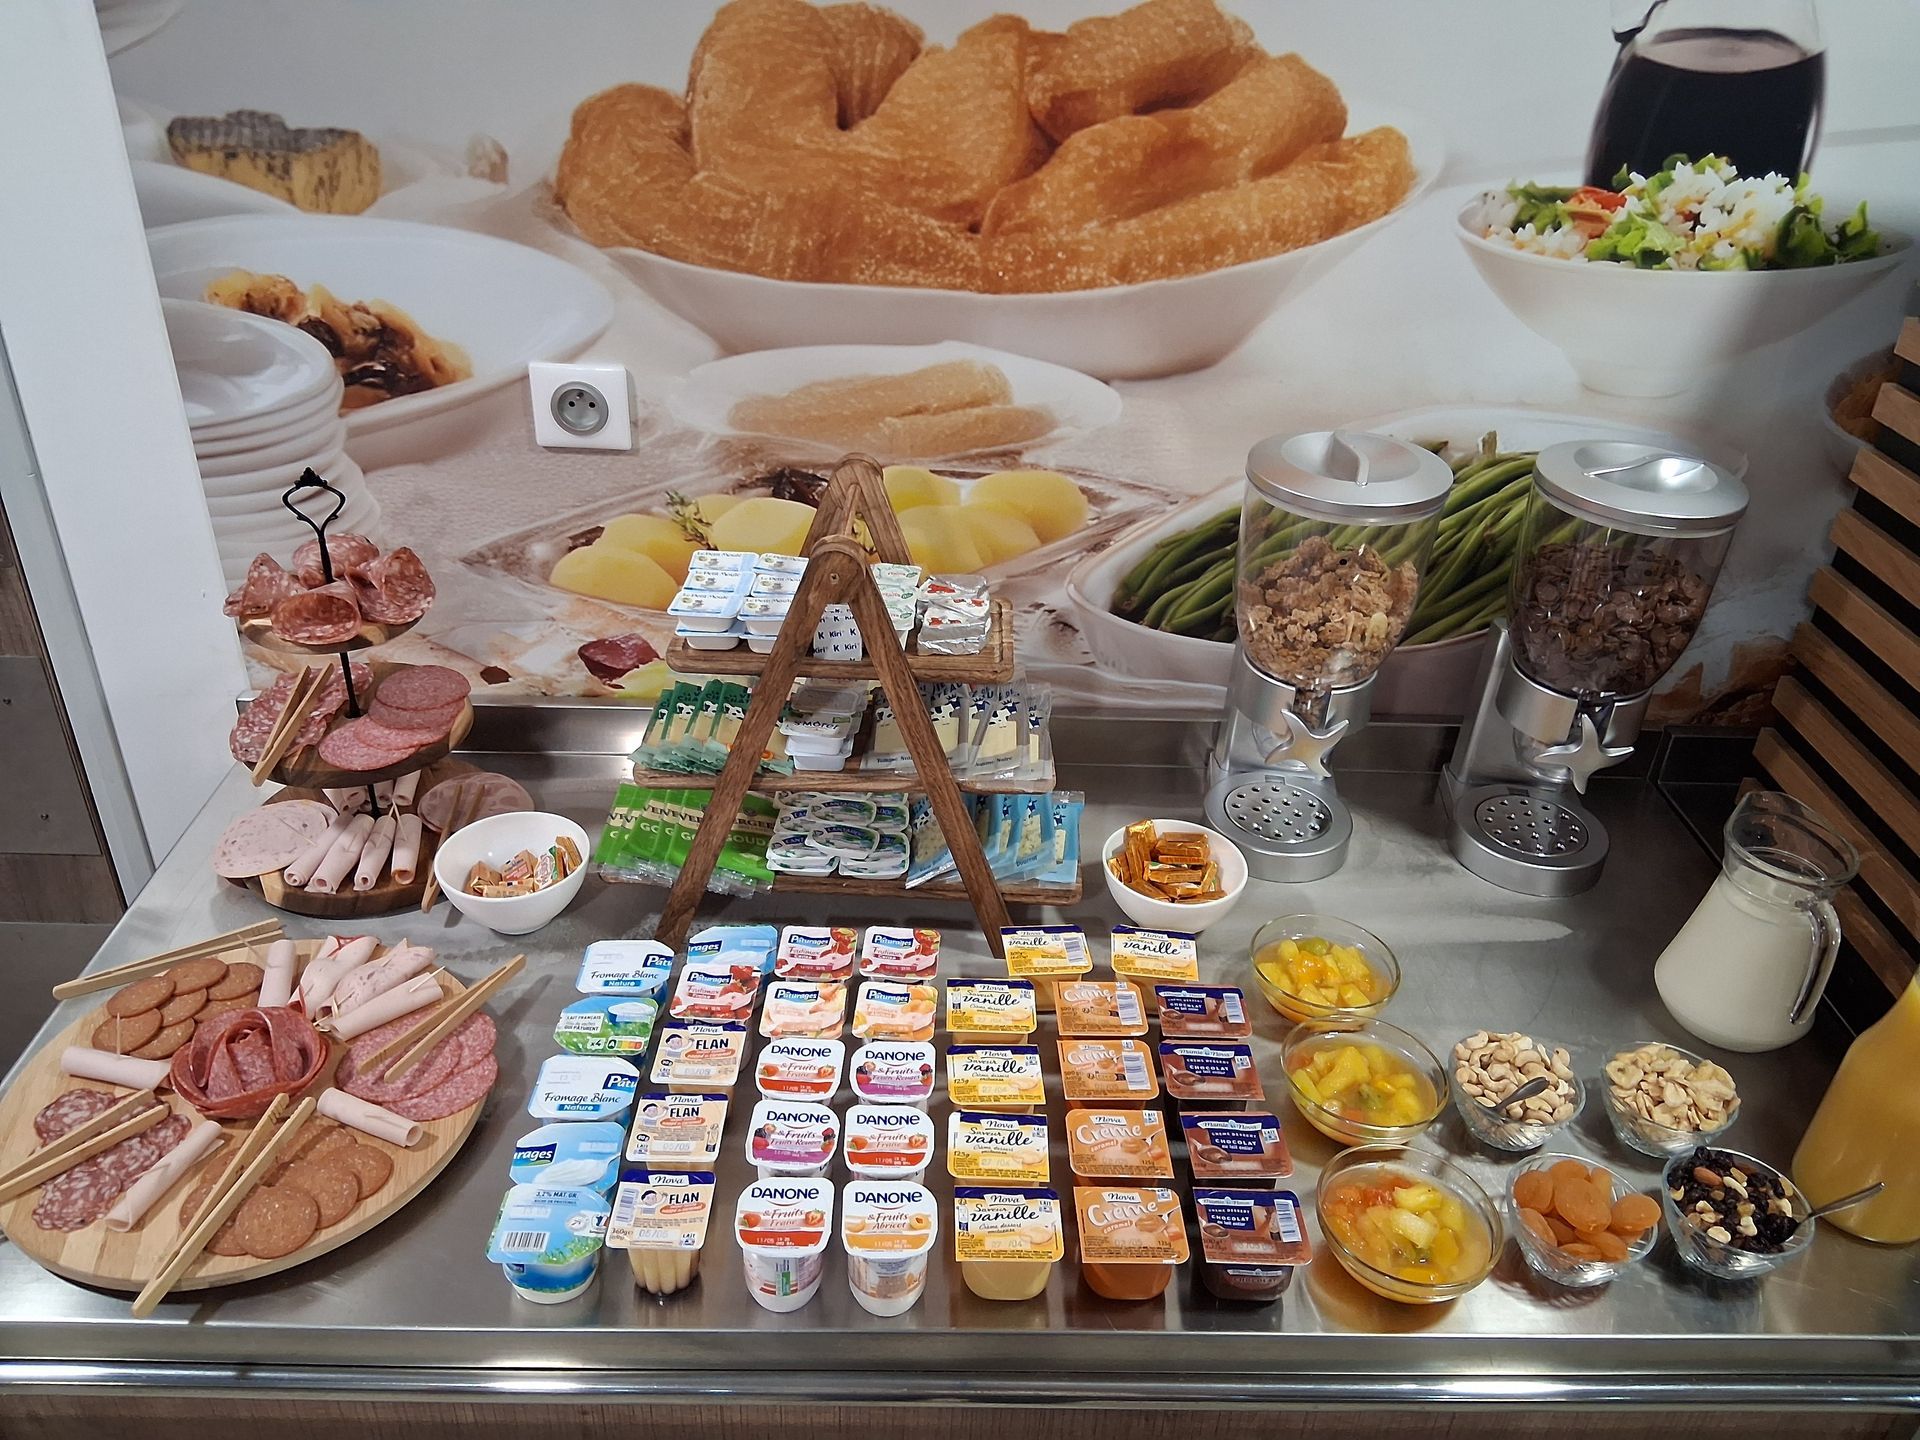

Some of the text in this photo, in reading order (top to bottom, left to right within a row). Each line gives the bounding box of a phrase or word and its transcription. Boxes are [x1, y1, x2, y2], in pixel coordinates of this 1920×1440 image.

[829, 630, 842, 638] Kiri
[844, 643, 857, 651] Kiri
[1122, 941, 1181, 956] vanille
[591, 970, 659, 982] Fromage Blanc
[777, 989, 818, 1000] Pâturages
[868, 990, 909, 1002] Pâturages
[961, 993, 1021, 1006] vanille
[590, 1040, 602, 1048] x4
[695, 1038, 730, 1050] FLAN
[770, 1045, 832, 1057] DANONE
[865, 1050, 926, 1061] DANONE
[966, 1056, 998, 1064] Saveur
[787, 1062, 817, 1072] Fruits
[884, 1066, 914, 1076] Fruits
[962, 1059, 1027, 1074] vanille
[1188, 1064, 1229, 1072] CHOCOLAT
[544, 1091, 622, 1104] Fromage Blanc
[670, 1096, 699, 1104] Nova
[562, 1104, 594, 1112] Nature
[669, 1106, 700, 1118] FLAN
[766, 1110, 831, 1124] DANONE
[856, 1114, 921, 1126] DANONE
[985, 1119, 1015, 1129] Nova
[784, 1130, 817, 1140] Fruits
[968, 1126, 1003, 1137] Saveur
[1076, 1124, 1142, 1146] Crème
[876, 1132, 908, 1143] Fruits
[963, 1131, 1034, 1147] vanille
[1214, 1138, 1258, 1147] CHOCOLAT
[654, 1175, 684, 1185] Nova
[668, 1192, 700, 1205] FLAN
[750, 1186, 820, 1200] DANONE
[854, 1191, 923, 1204] DANONE
[1107, 1192, 1137, 1201] Nova
[990, 1194, 1021, 1204] Nova
[770, 1208, 805, 1219] Fruits
[969, 1205, 1040, 1222] vanille
[974, 1203, 1008, 1213] Saveur
[875, 1211, 909, 1223] Fruits
[1087, 1201, 1158, 1227] Crème
[1210, 1214, 1250, 1222] CHOCOLAT
[872, 1221, 907, 1230] Abricot
[1102, 1219, 1132, 1236] caramel
